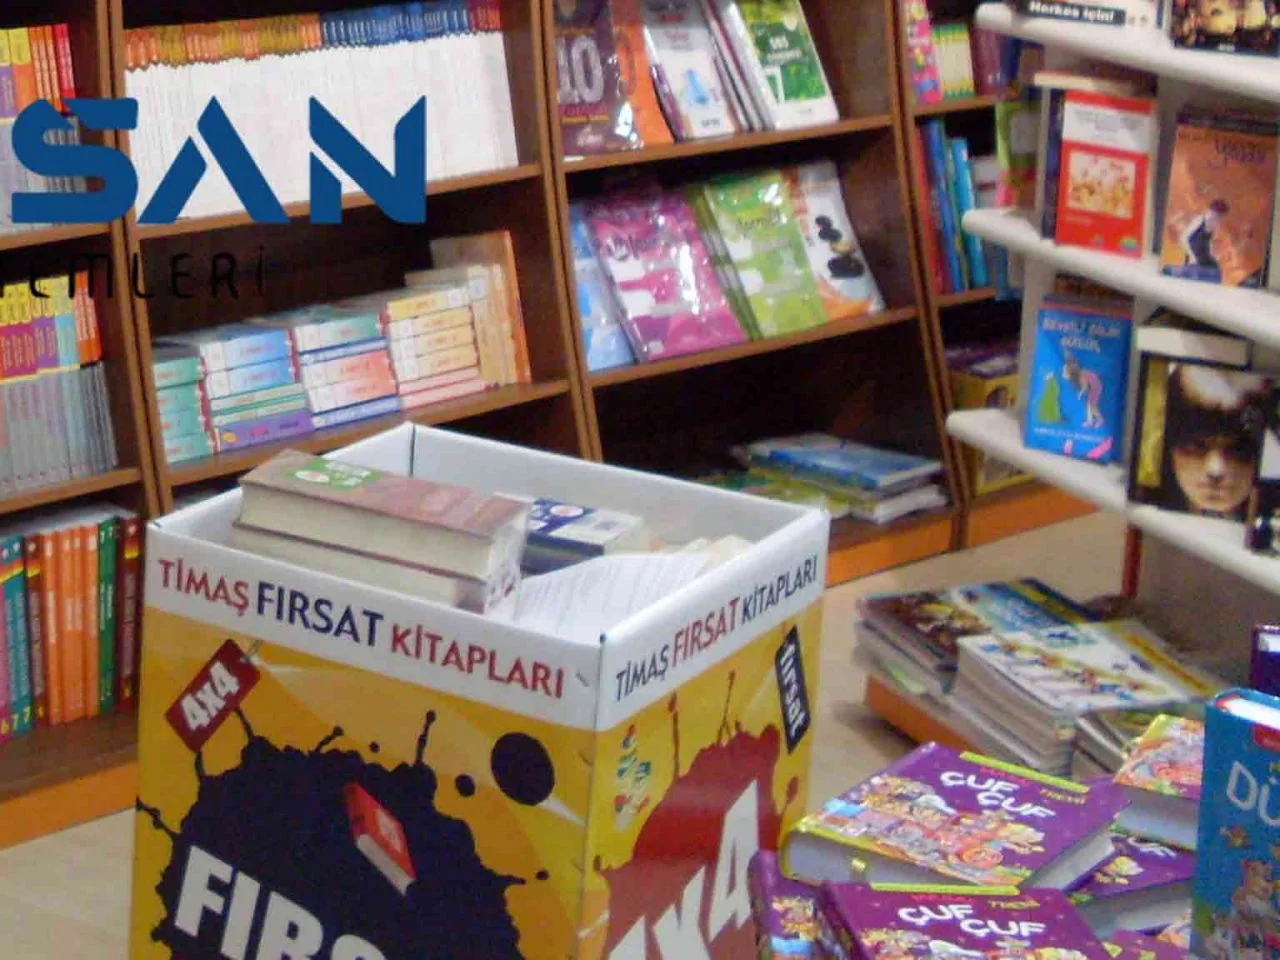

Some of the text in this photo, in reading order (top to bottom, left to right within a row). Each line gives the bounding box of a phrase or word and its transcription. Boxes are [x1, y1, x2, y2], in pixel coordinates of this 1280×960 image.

[158, 554, 566, 700] TİMAŞ FIRSAT KİTAPLARI
[616, 555, 818, 701] TİMAŞ FIRSAT KİTAPLARI
